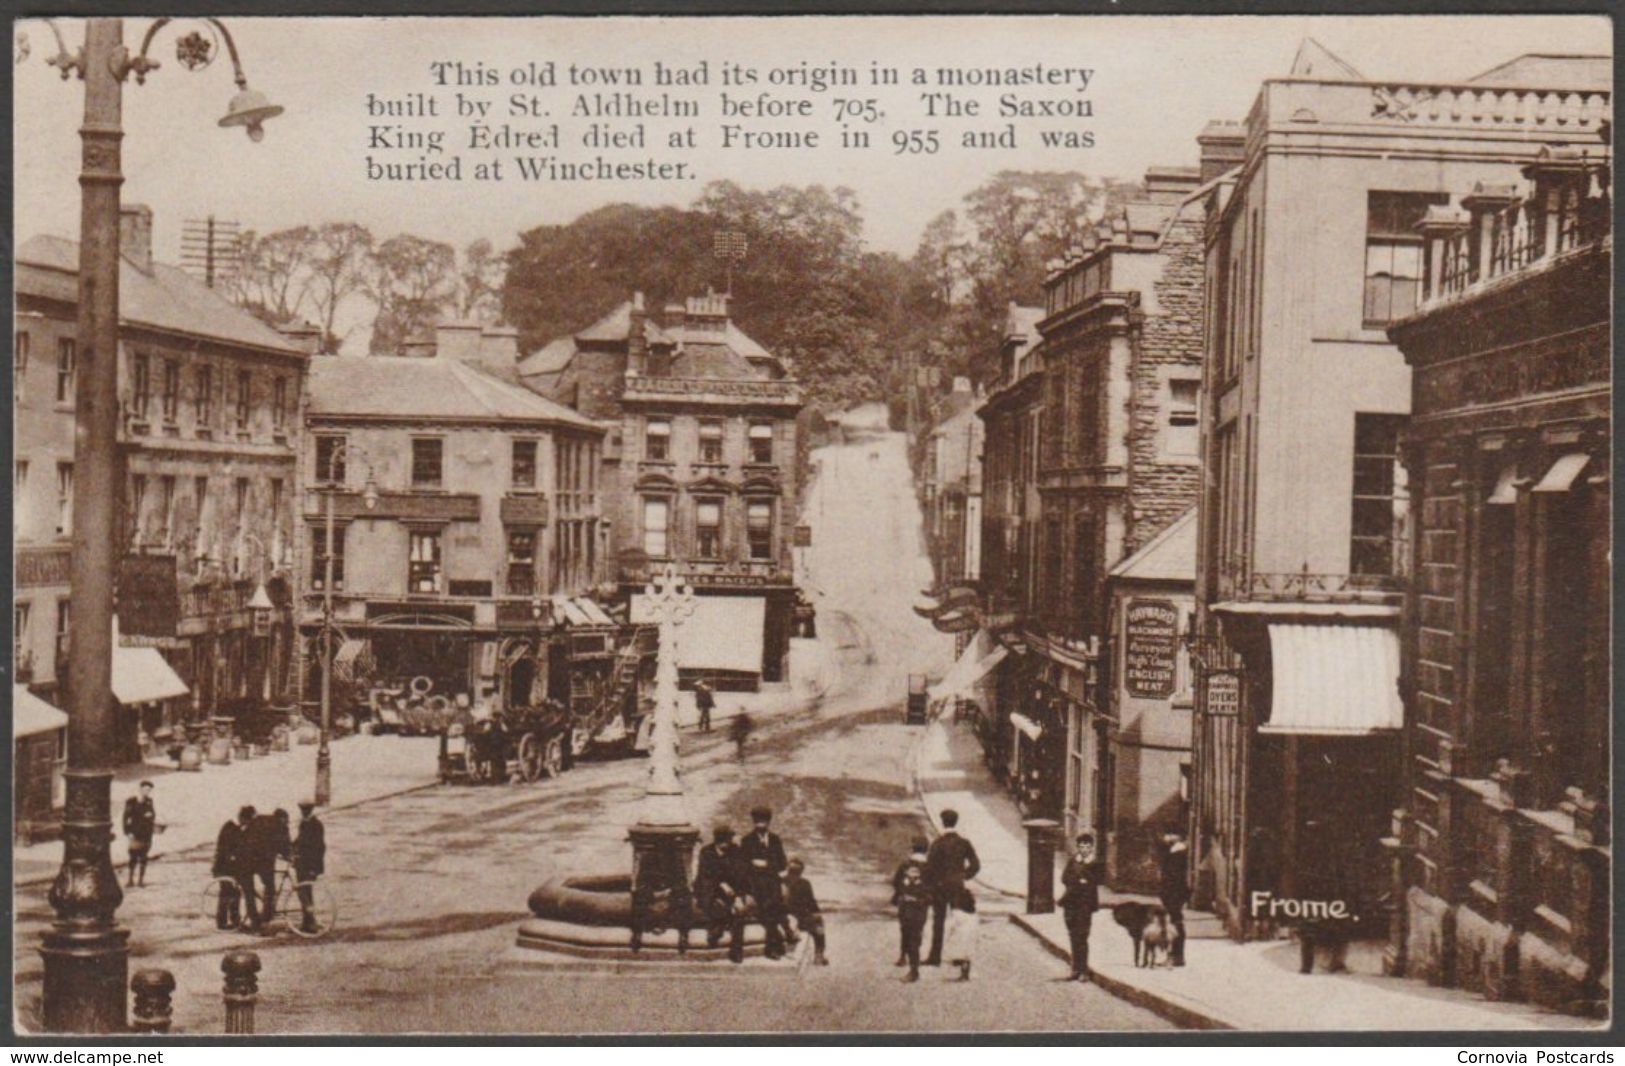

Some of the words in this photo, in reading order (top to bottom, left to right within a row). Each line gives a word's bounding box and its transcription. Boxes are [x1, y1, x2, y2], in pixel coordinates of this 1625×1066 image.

[1129, 607, 1176, 625] HAYWARD
[1128, 669, 1171, 680] ENGLISH
[1136, 681, 1164, 691] MEAT
[1210, 691, 1237, 702] DYERS
